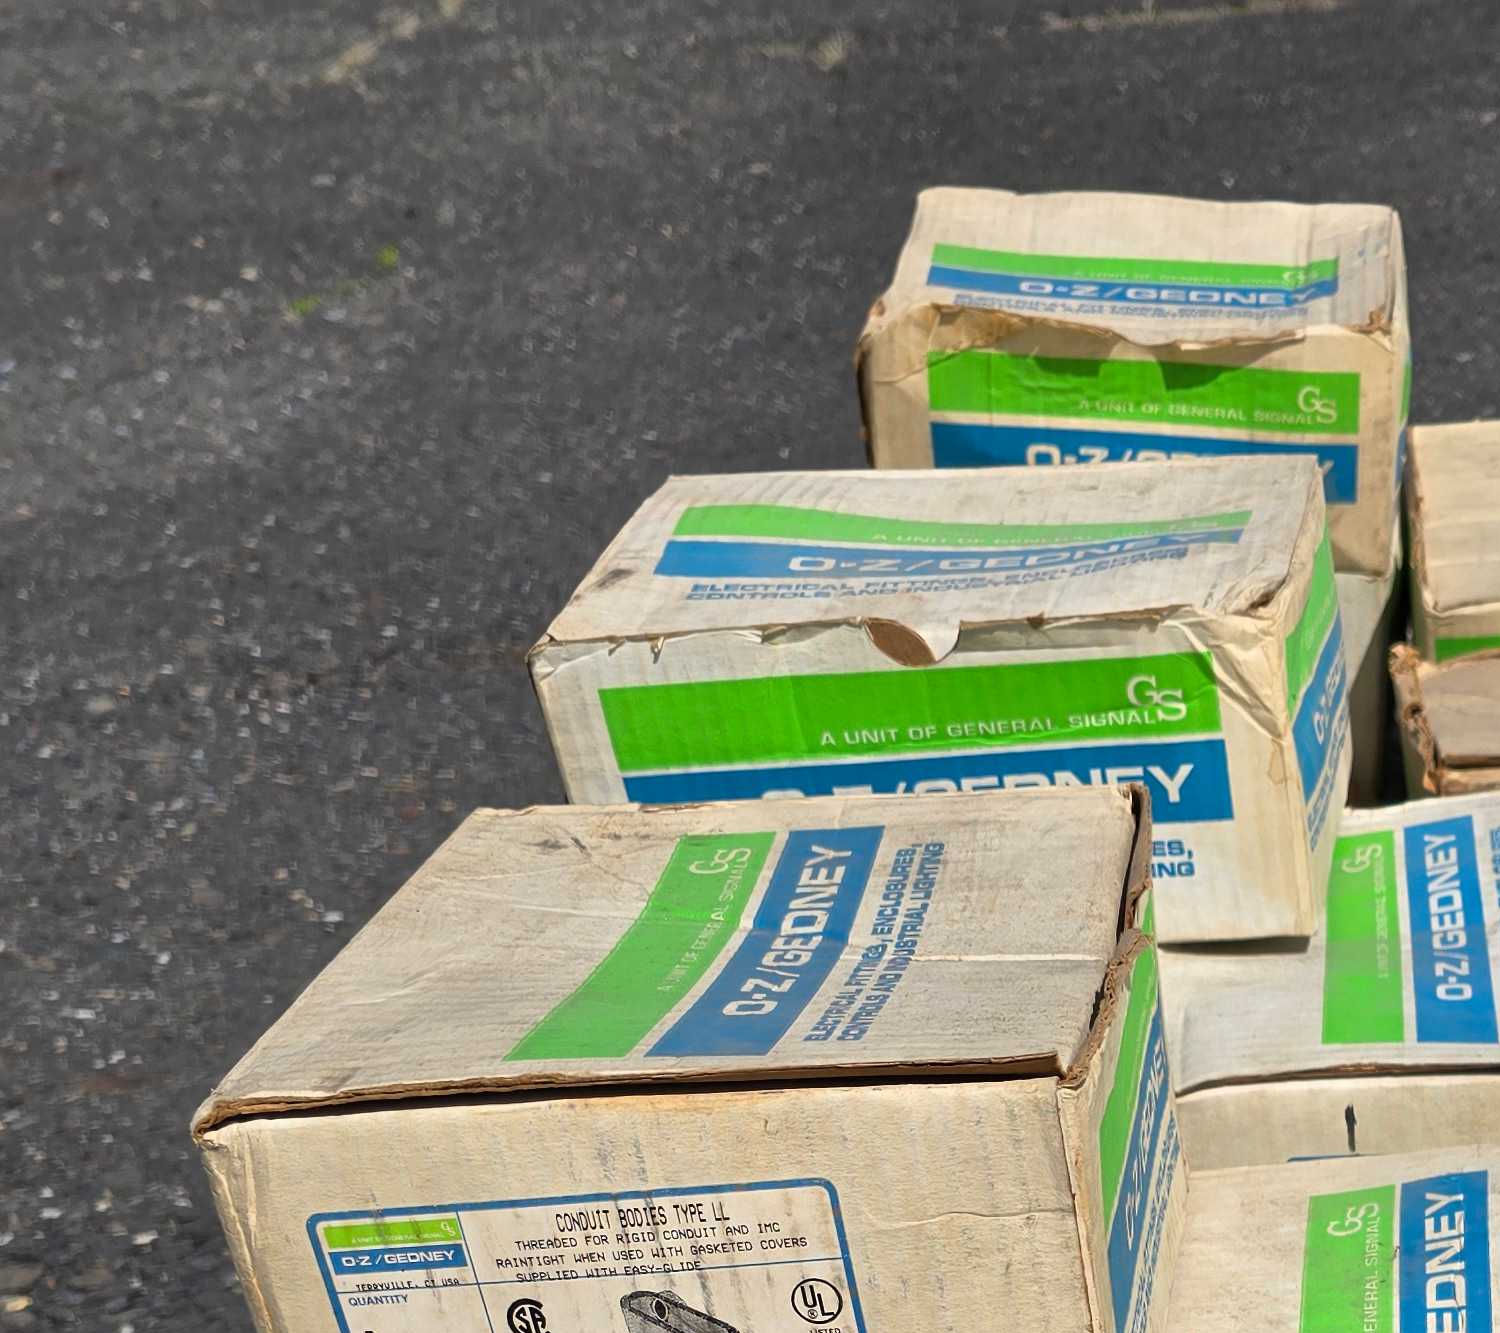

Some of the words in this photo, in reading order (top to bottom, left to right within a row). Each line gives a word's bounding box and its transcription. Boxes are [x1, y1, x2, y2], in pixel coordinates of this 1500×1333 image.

[821, 732, 836, 747] A
[845, 729, 897, 745] UNIT
[909, 726, 936, 741] OF
[947, 719, 1055, 737] GENERAL
[1069, 712, 1159, 728] SIGNAL
[722, 845, 852, 1017] O-Z/GEDNEY
[1424, 834, 1472, 1001] O-Z/GEDNEY
[618, 1206, 668, 1228] BODIES
[672, 1204, 707, 1224] TYPE
[713, 1201, 730, 1221] LL
[514, 1238, 577, 1251] THREADED
[585, 1234, 609, 1246] FOR
[616, 1231, 657, 1244] RIGID
[725, 1225, 749, 1236] AND
[757, 1222, 780, 1233] IMC
[342, 1250, 455, 1266] O-Z/GEDNEY
[496, 1255, 566, 1268] RAINTIGHT
[574, 1251, 605, 1264] WHEN
[613, 1249, 643, 1261] USED
[651, 1245, 683, 1259] WITH
[690, 1241, 753, 1255] GASKETED
[761, 1237, 807, 1250] COVERS
[516, 1270, 578, 1283] SUPPLIED
[586, 1268, 617, 1278] WITH
[624, 1262, 702, 1276] EASY-GLIDE
[349, 1294, 408, 1307] QUANTITY
